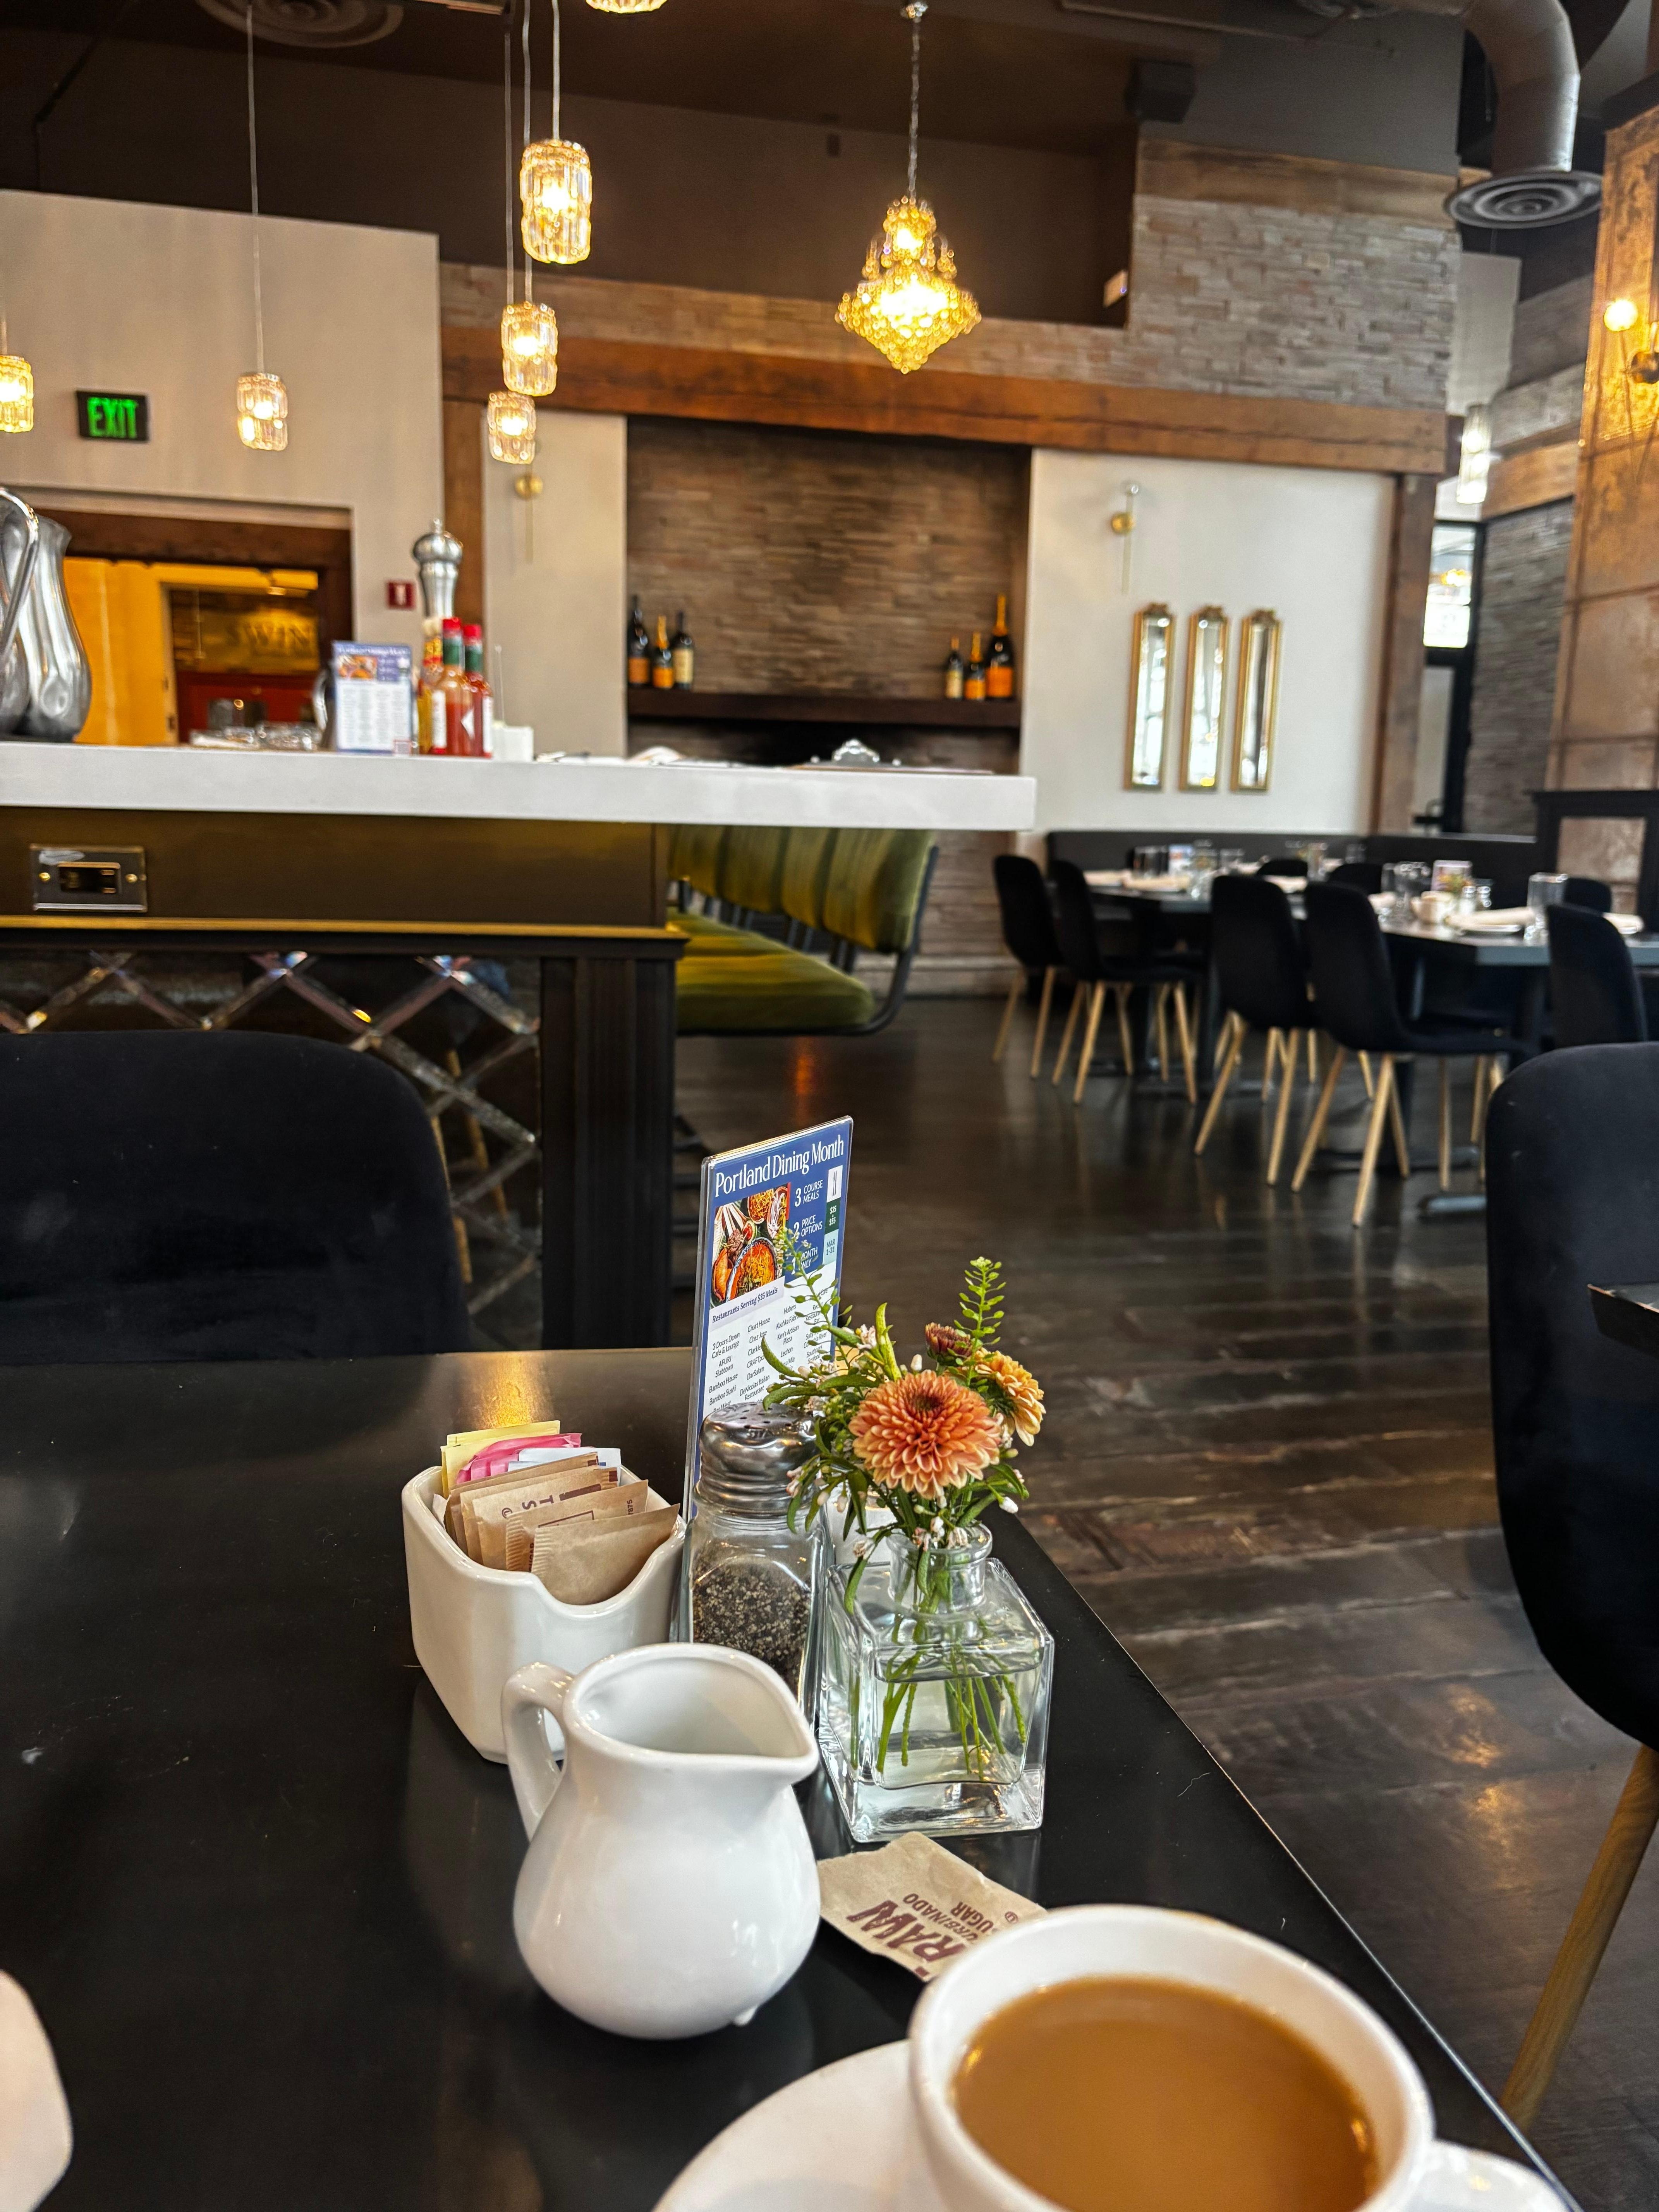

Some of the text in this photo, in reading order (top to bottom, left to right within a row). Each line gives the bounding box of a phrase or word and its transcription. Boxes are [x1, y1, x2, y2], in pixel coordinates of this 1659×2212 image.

[88, 397, 138, 438] EXIT
[715, 1135, 844, 1197] Portland Dining Month
[795, 1180, 823, 1207] 3 COURSE
[803, 1190, 819, 1204] MEALS
[794, 1215, 816, 1240] 2 PRICE
[801, 1221, 823, 1237] OPTIONS
[826, 1239, 835, 1248] MAR
[826, 1247, 835, 1255] 1-31
[712, 1305, 739, 1323] Restaurants
[740, 1297, 757, 1310] Serving
[766, 1287, 778, 1298] Meals
[748, 1317, 770, 1333] Chart House
[716, 1338, 728, 1348] Doors
[728, 1333, 740, 1343] Down
[749, 1334, 759, 1343] Chez
[778, 1326, 799, 1340] Ken's Artisan
[783, 1336, 792, 1345] Pizza
[726, 1341, 739, 1352] Lounge
[781, 1347, 793, 1357] Lechon
[718, 1355, 732, 1368] AFURI
[709, 1373, 738, 1393] Bamboo House
[759, 1375, 770, 1385] Italian
[709, 1385, 736, 1406] Bamboo Sushi
[745, 1385, 764, 1400] Restaurant
[903, 1893, 979, 1941] URBINADO
[950, 1901, 994, 1933] UGAR
[846, 1900, 965, 1961] RAW
